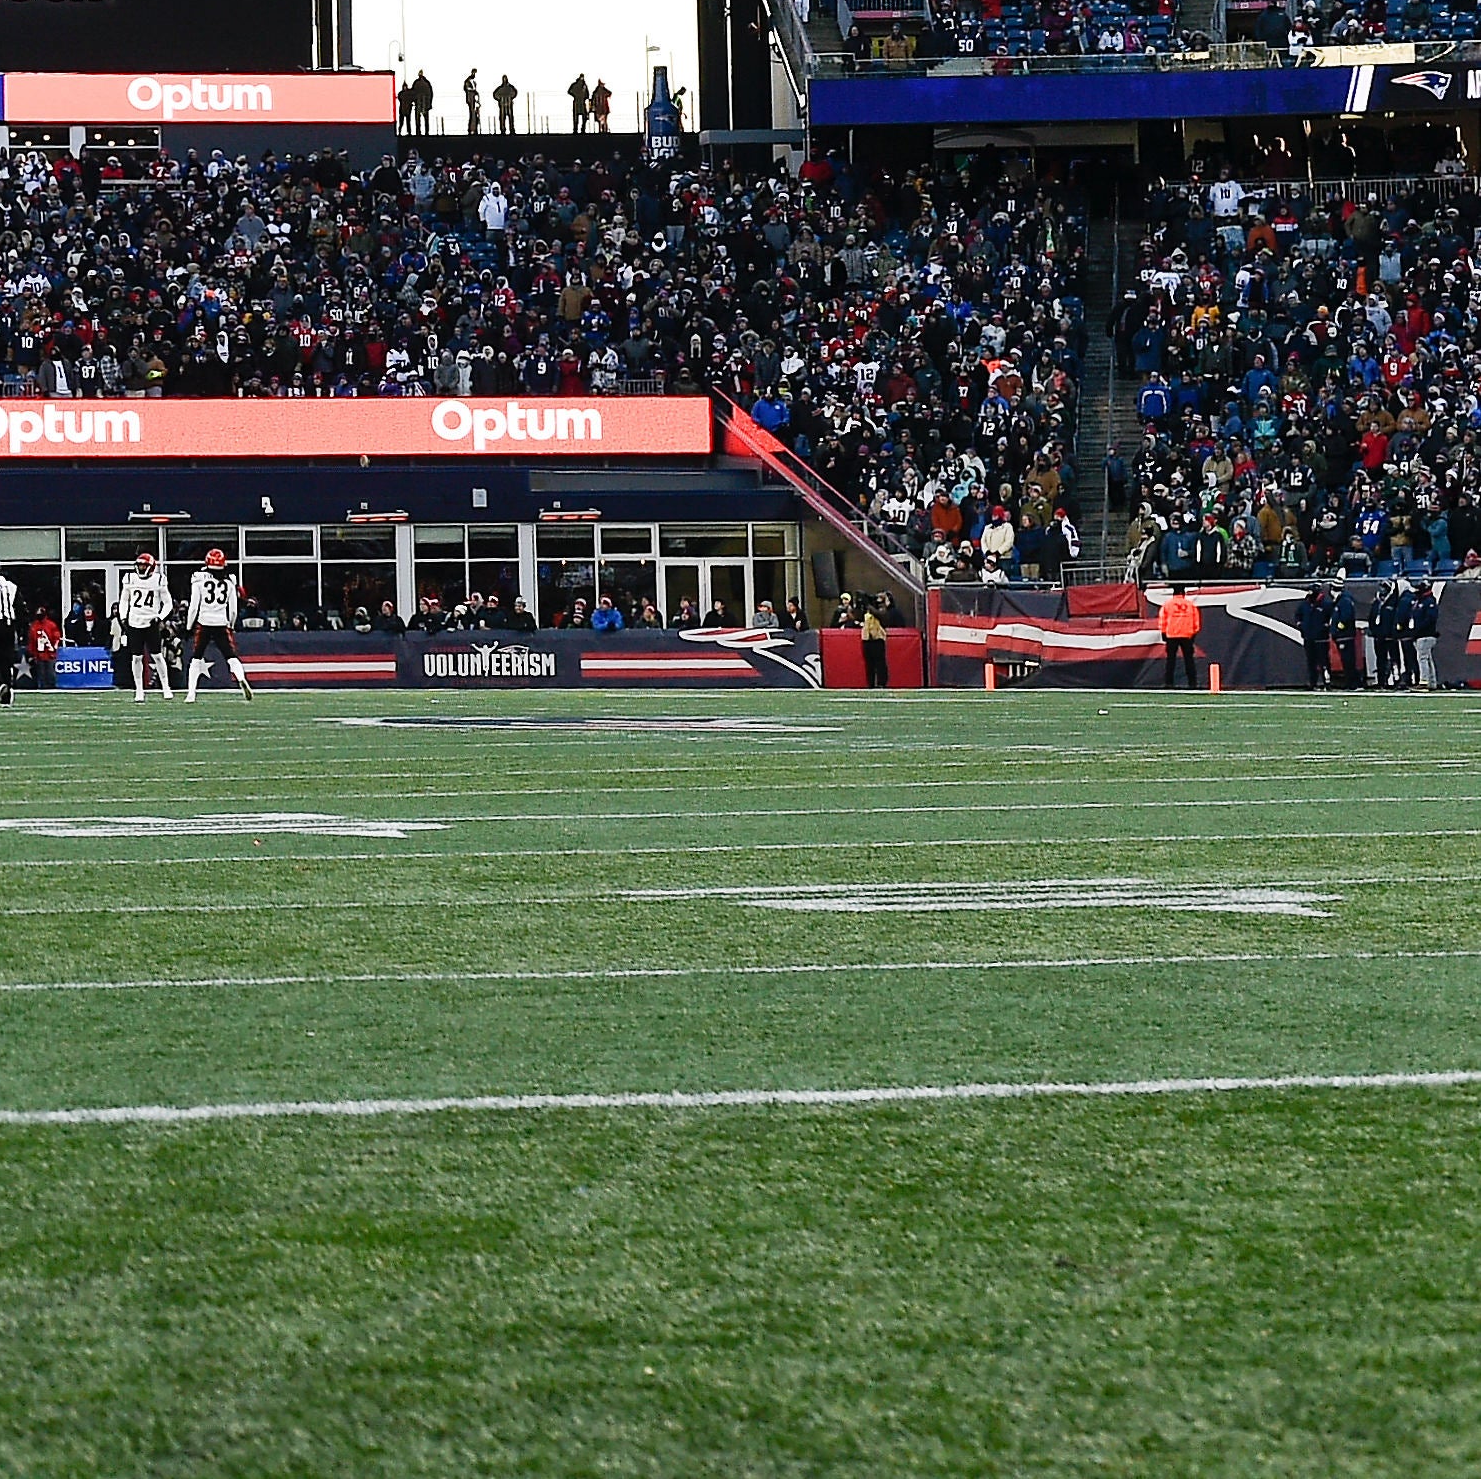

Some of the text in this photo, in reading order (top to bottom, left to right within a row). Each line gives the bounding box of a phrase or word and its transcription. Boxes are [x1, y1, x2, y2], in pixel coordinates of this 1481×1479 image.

[127, 76, 272, 119] Optum
[430, 400, 603, 450] Optum
[133, 589, 155, 608] 24
[203, 581, 228, 604] 33
[55, 660, 114, 673] CBS NFL
[423, 653, 556, 678] VOLUNTEERISM
